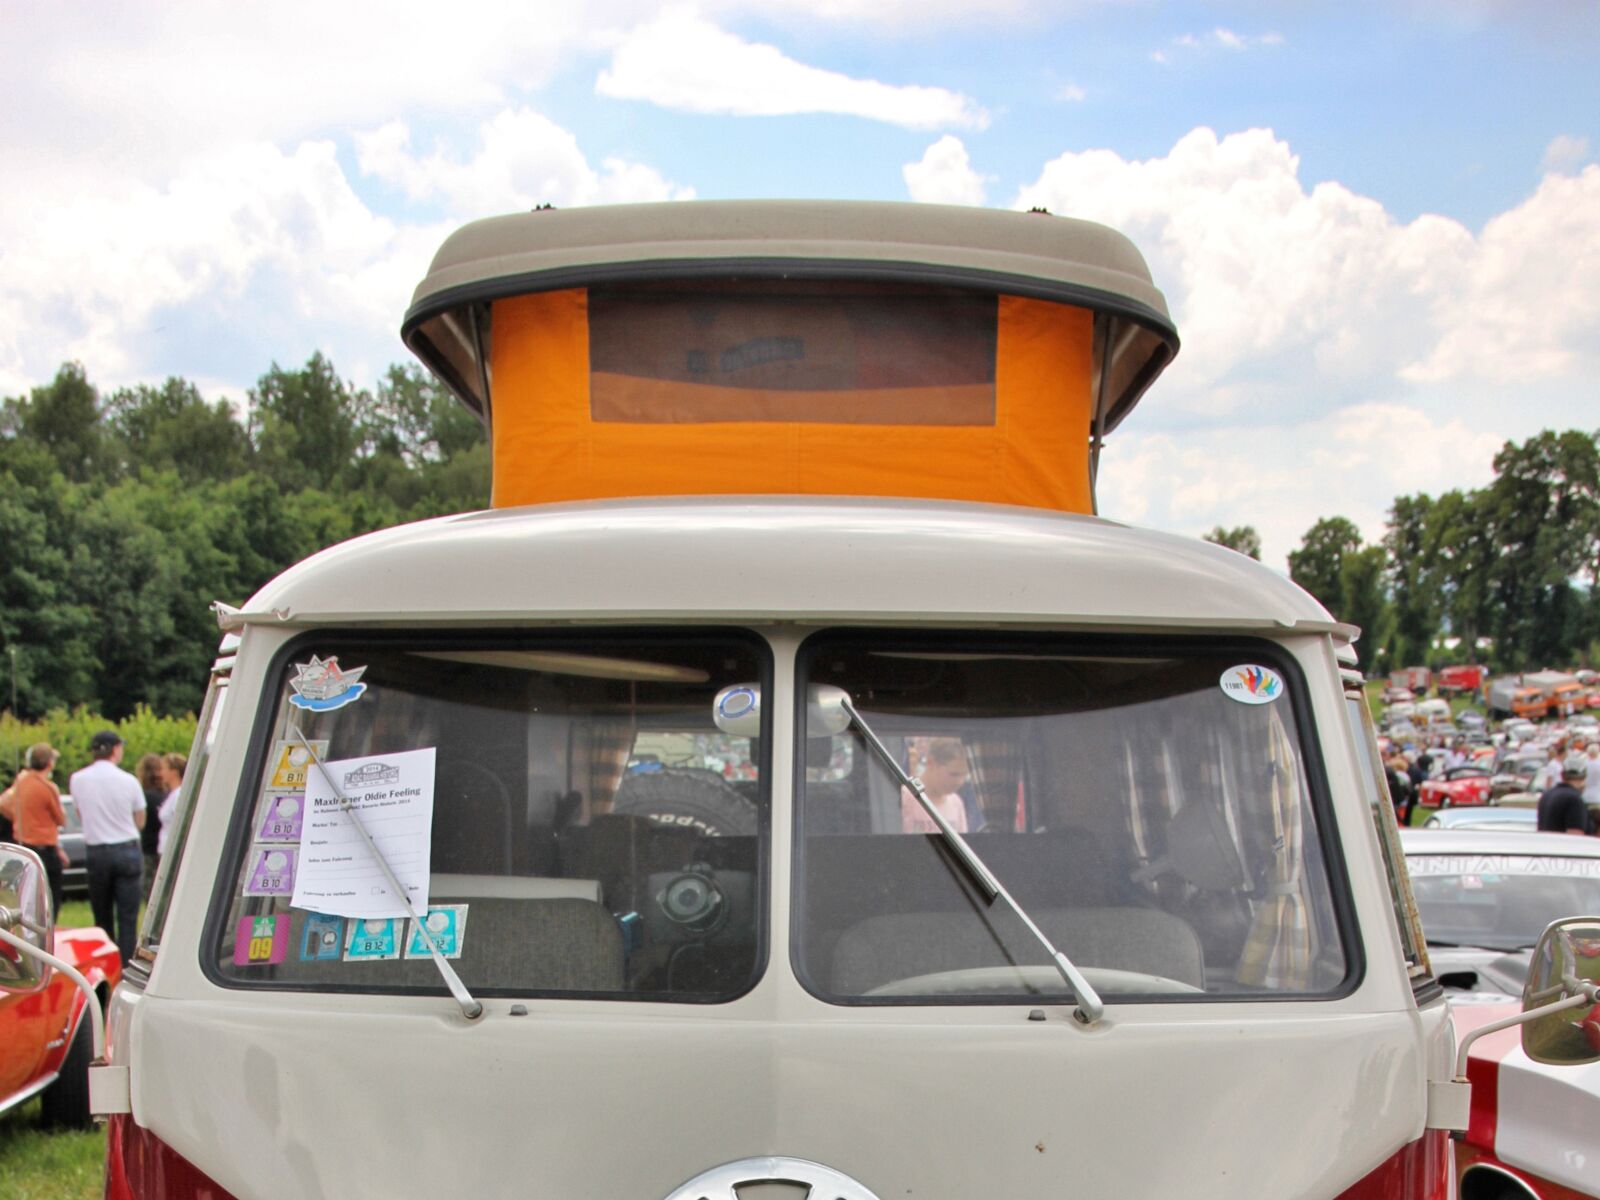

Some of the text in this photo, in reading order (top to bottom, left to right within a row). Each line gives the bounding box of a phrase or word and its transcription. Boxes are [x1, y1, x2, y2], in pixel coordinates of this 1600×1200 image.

[364, 791, 387, 801] Oldie
[389, 787, 421, 798] Feeling
[273, 824, 293, 833] B 10
[261, 878, 280, 888] B 10
[249, 937, 273, 960] 09
[365, 941, 384, 951] B 12
